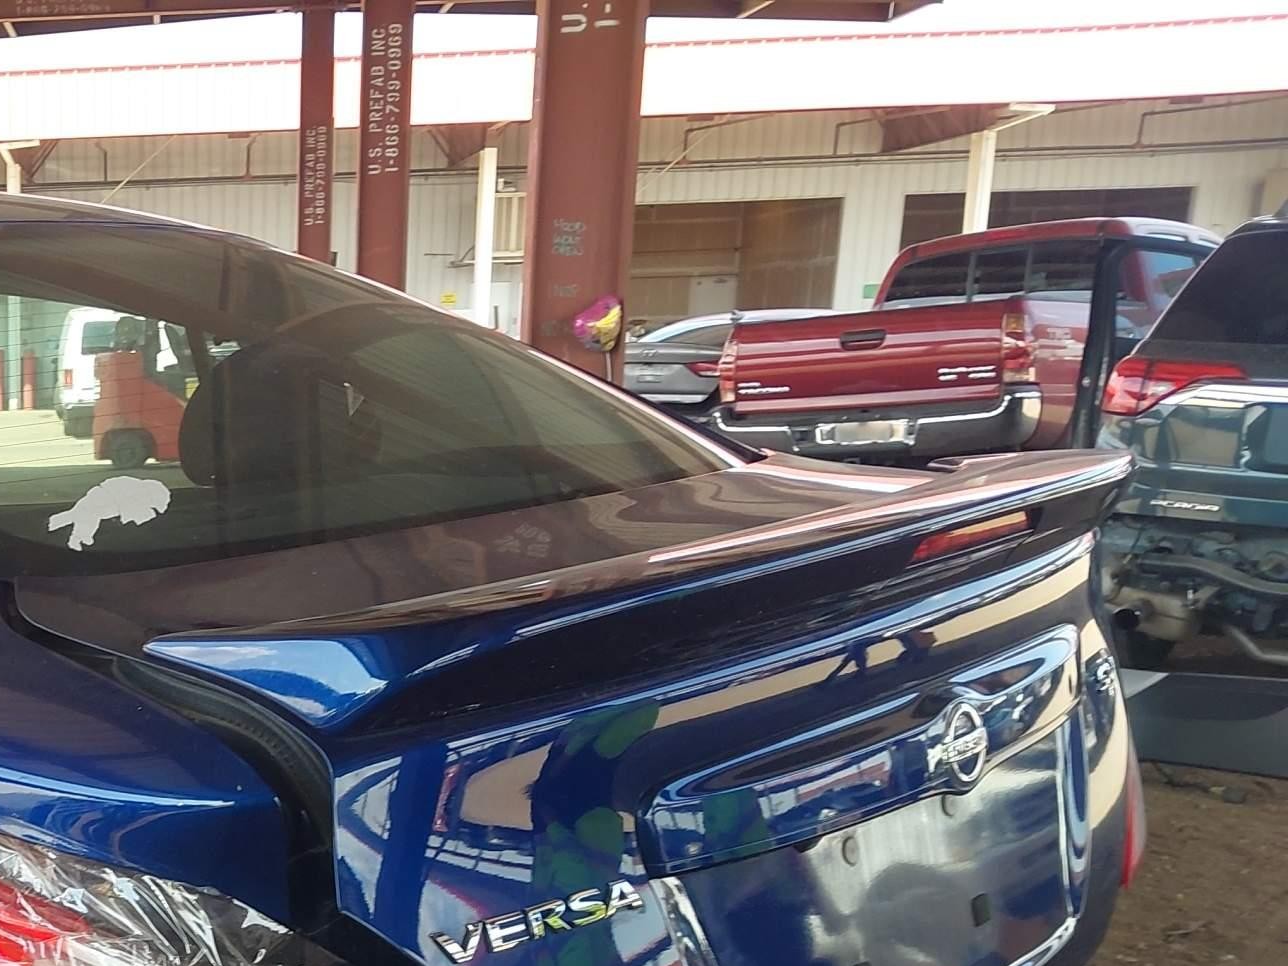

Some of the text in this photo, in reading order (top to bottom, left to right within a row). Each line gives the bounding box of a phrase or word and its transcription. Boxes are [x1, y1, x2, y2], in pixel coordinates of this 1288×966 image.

[368, 65, 385, 133] PREFAB
[385, 23, 403, 172] 1-866-799-0969
[429, 879, 644, 964] VERSA
